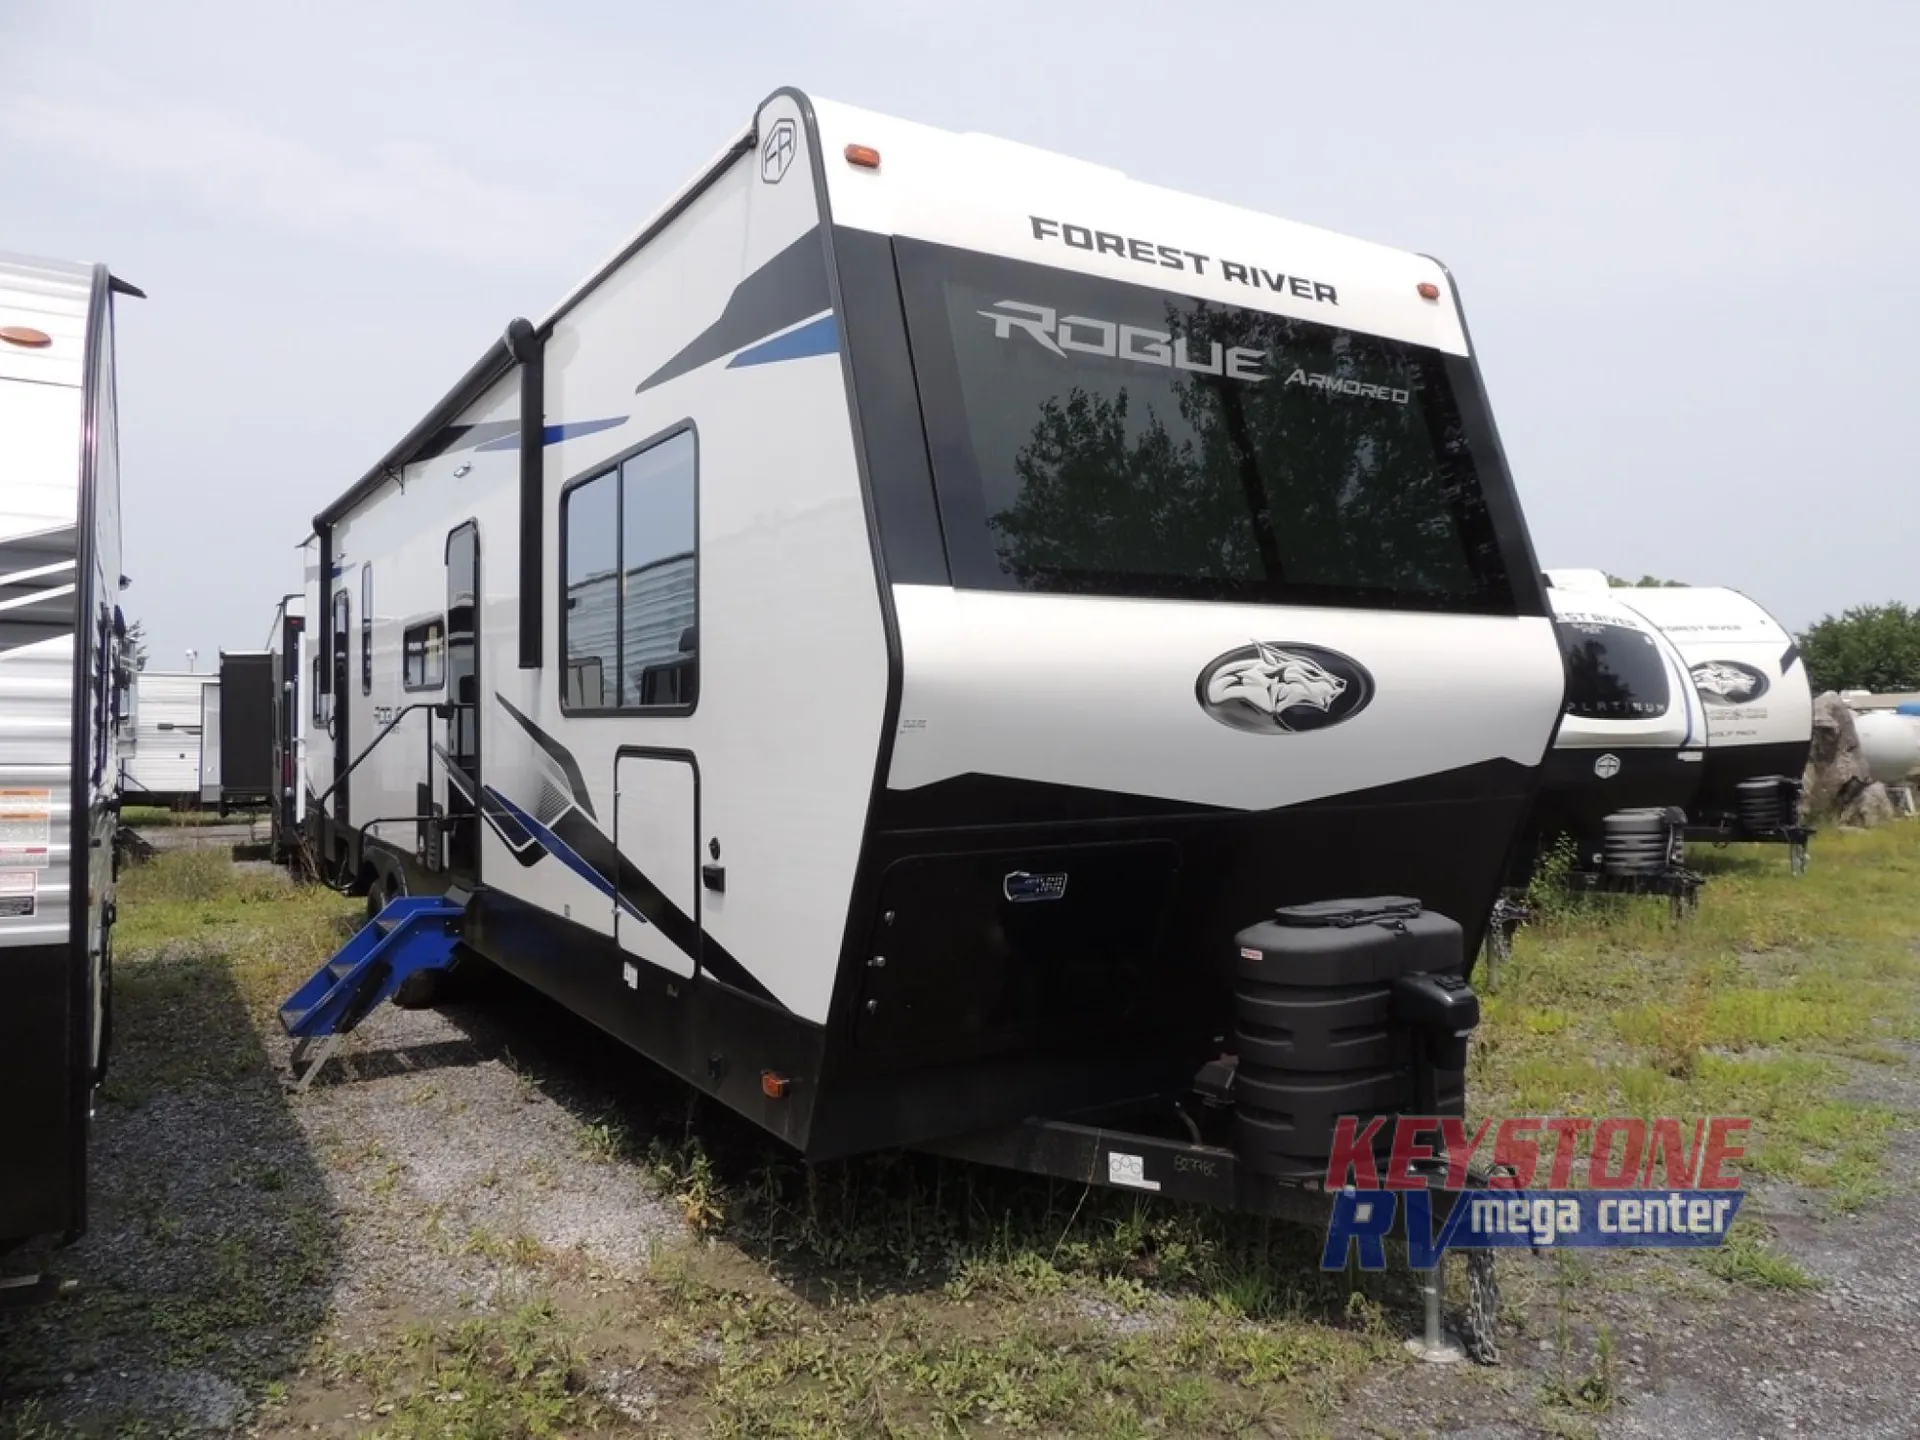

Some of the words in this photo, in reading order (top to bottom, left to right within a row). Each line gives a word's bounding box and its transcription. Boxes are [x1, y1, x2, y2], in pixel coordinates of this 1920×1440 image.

[1028, 215, 1210, 274] FOREST
[1220, 259, 1339, 306] RIVER
[977, 299, 1270, 382] ROGUE
[1284, 368, 1410, 404] ARMORED
